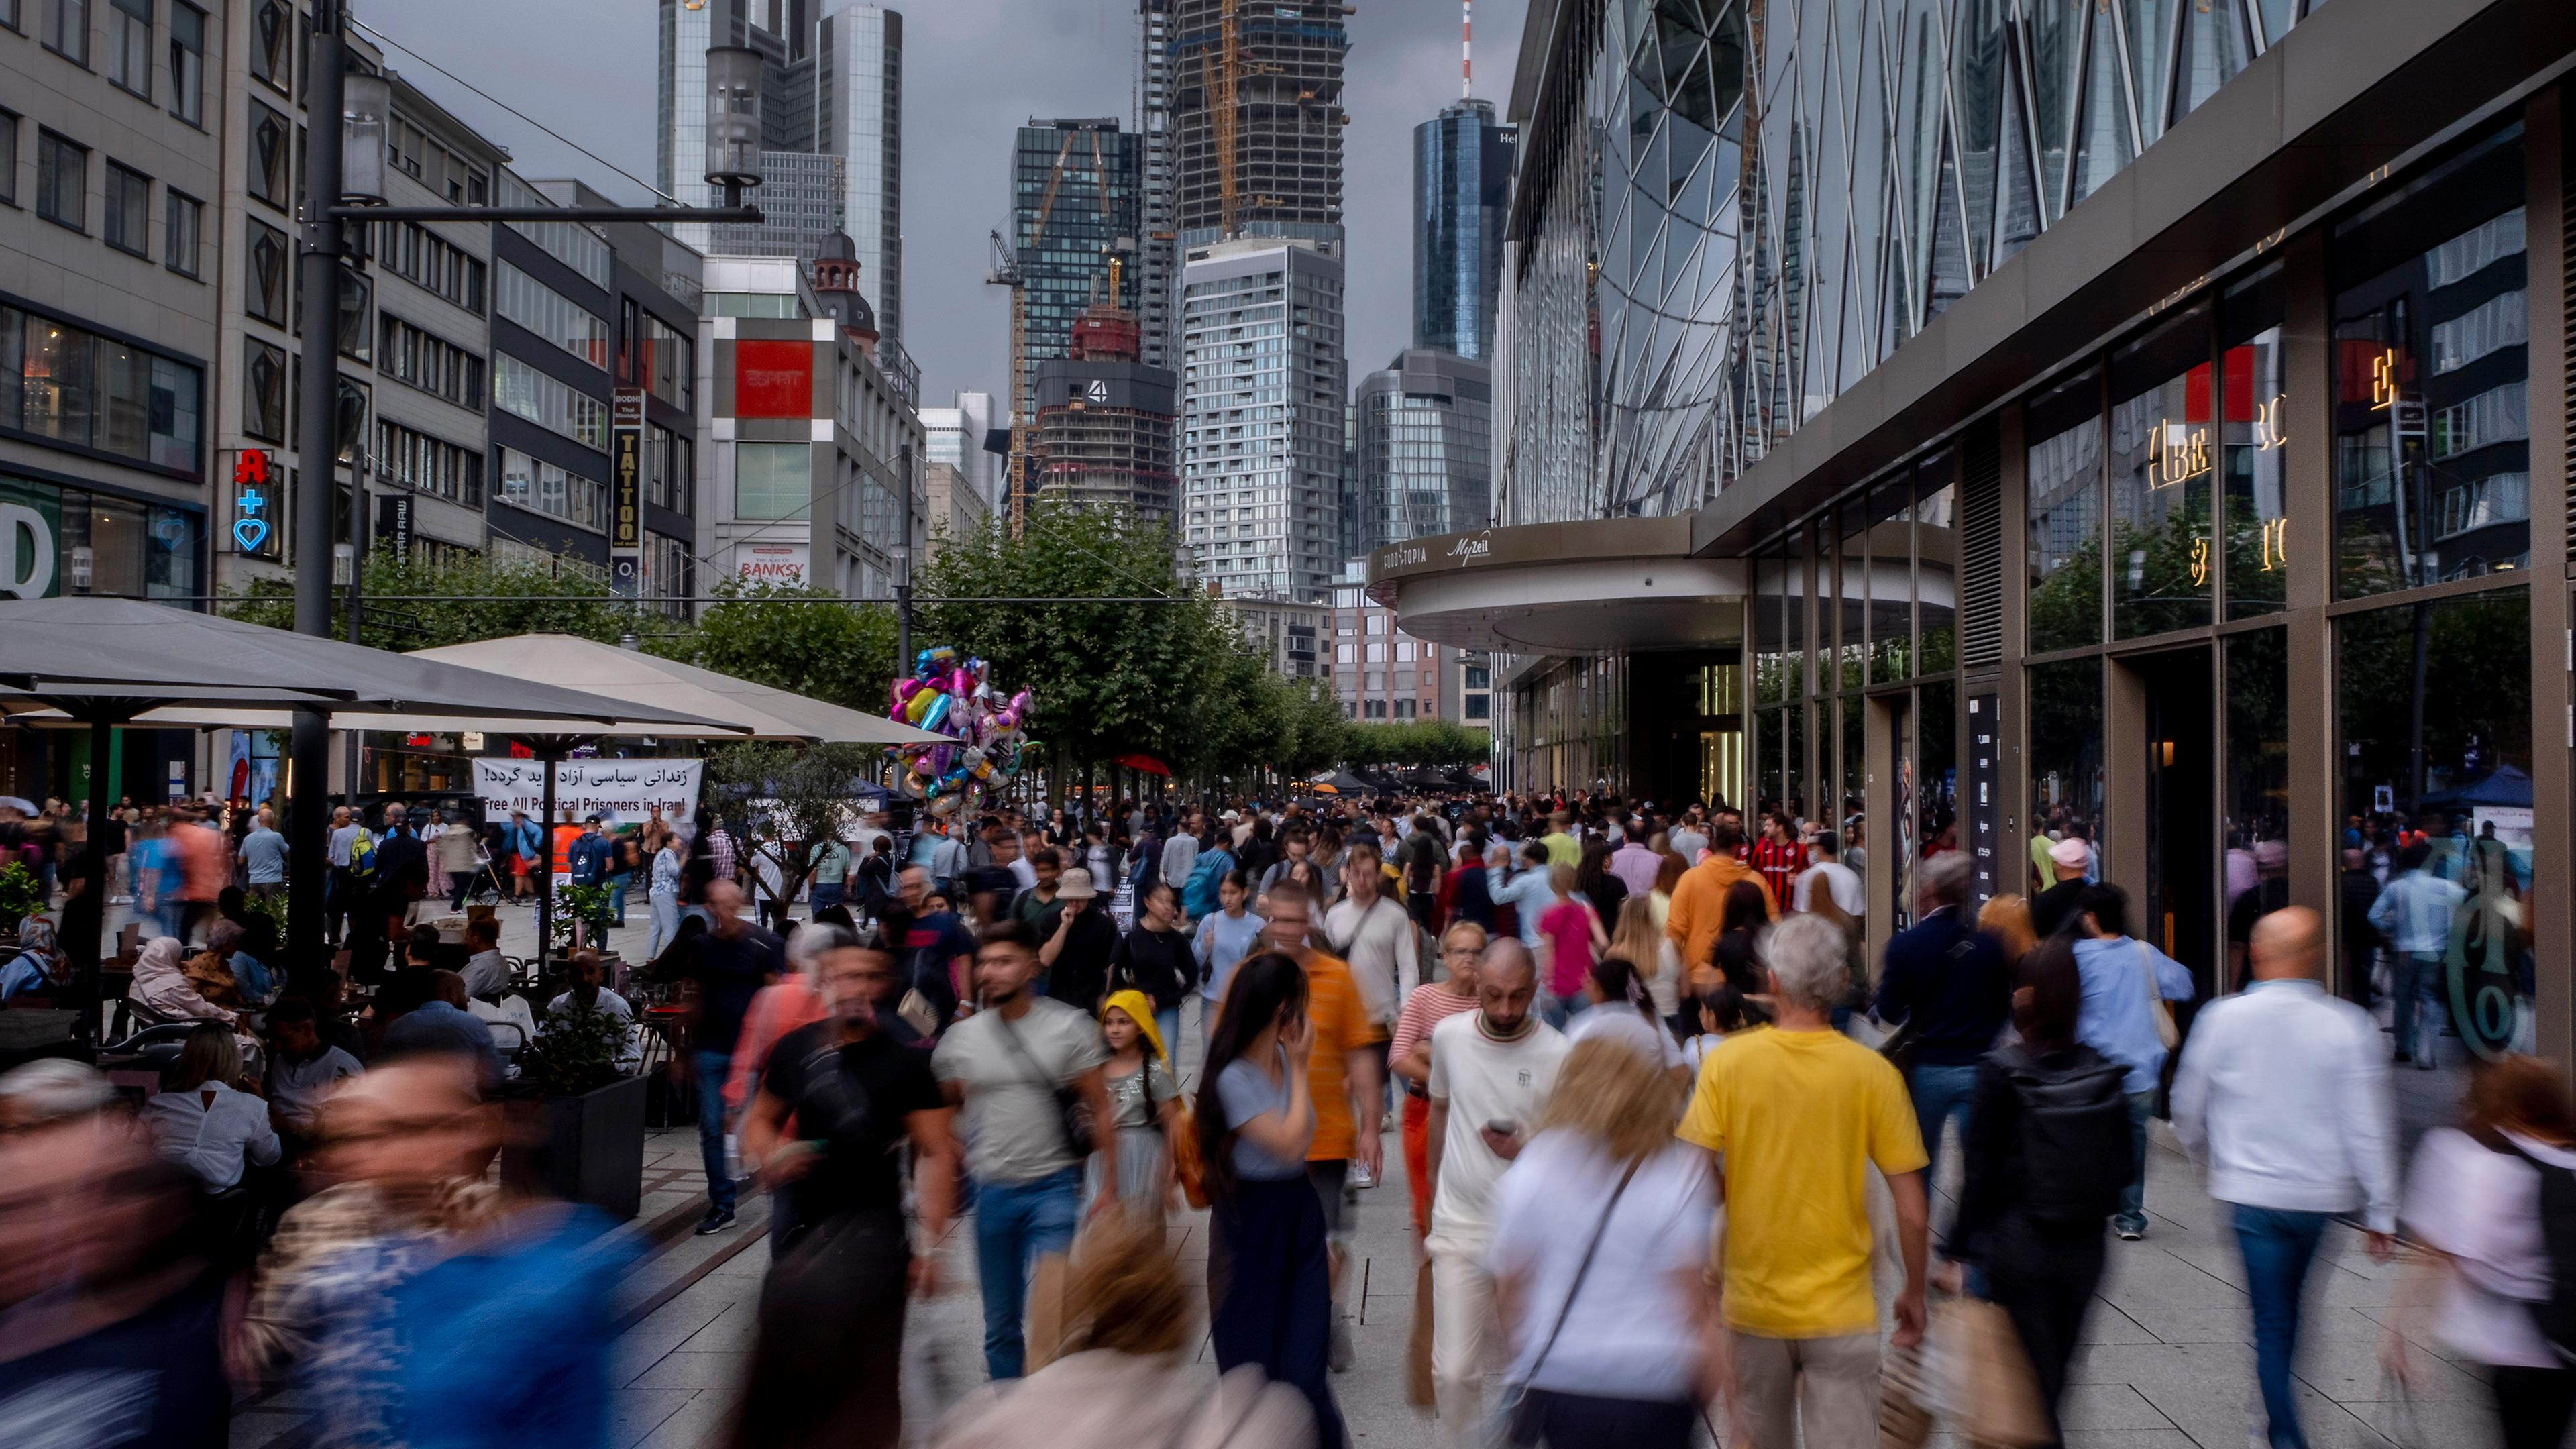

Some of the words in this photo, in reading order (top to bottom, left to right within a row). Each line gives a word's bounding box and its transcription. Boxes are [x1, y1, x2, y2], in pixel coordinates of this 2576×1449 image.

[745, 370, 803, 386] ESPRIT
[620, 435, 635, 540] TATTOO
[398, 500, 407, 529] RAW
[1446, 538, 1489, 567] MyZeil
[741, 563, 804, 576] BANKSY
[484, 767, 521, 787] گردد!
[559, 765, 584, 787] آزاد
[590, 769, 637, 788] سیاسی
[644, 769, 688, 787] زندانی
[484, 797, 508, 810] Free
[513, 797, 527, 810] All
[583, 797, 639, 811] Prisoners
[643, 797, 654, 811] in
[657, 797, 685, 811] Iran!
